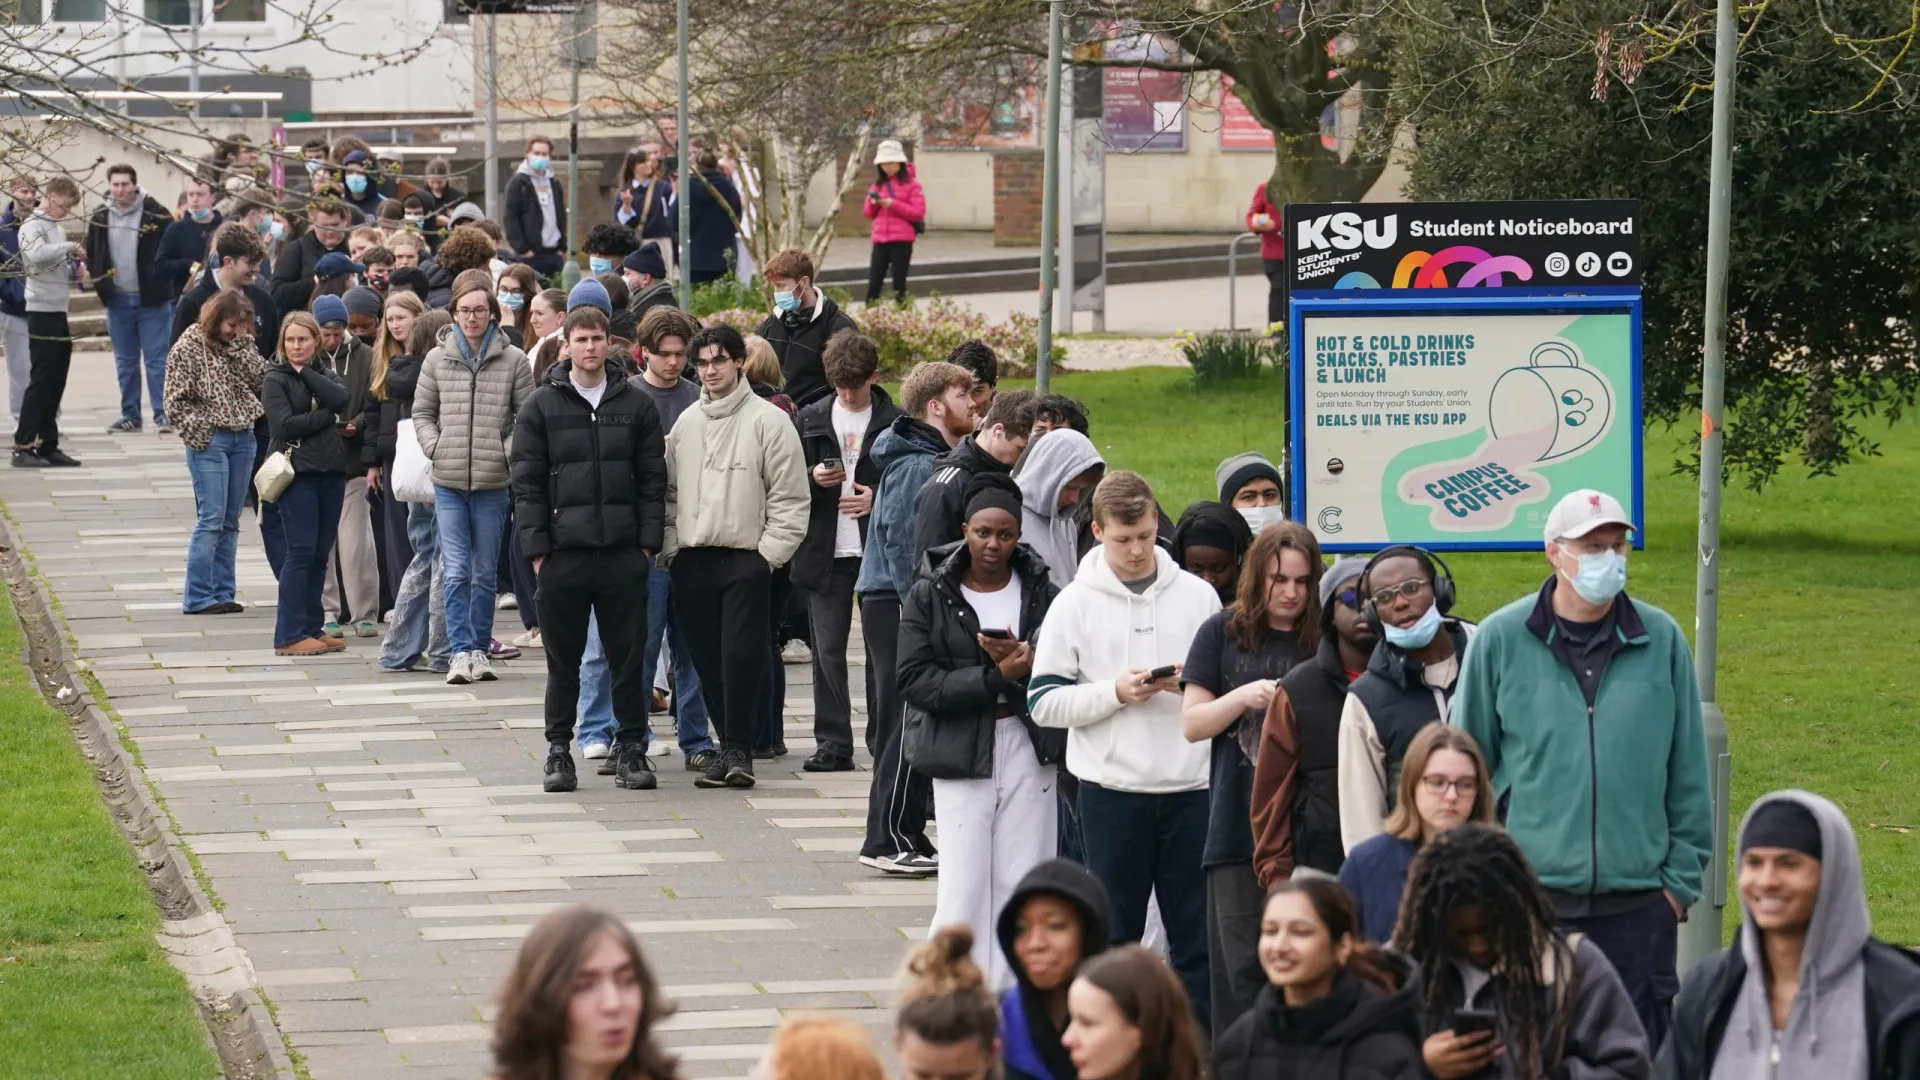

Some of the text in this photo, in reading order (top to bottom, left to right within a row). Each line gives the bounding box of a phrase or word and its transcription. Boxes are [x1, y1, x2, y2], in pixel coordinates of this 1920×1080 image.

[1297, 212, 1398, 250] KSU
[1410, 217, 1632, 237] Student Noticeboard
[1297, 250, 1332, 266] KENT
[1297, 251, 1363, 274] STUDENTS'
[1297, 266, 1335, 280] UNION
[1317, 335, 1474, 351] HOT & COLD DRINKS
[1317, 351, 1466, 367] SNACKS, PASTRIES
[1317, 368, 1386, 383] & LUNCH
[1317, 389, 1468, 399] Open Monday through Sunday, early
[1374, 399, 1384, 409] by
[1386, 401, 1404, 409] your
[1406, 398, 1445, 407] Students'
[1317, 413, 1466, 426] DEALS VIA THE KSU APP
[1424, 462, 1507, 500] CAMPUS
[1443, 474, 1531, 518] COFFEE
